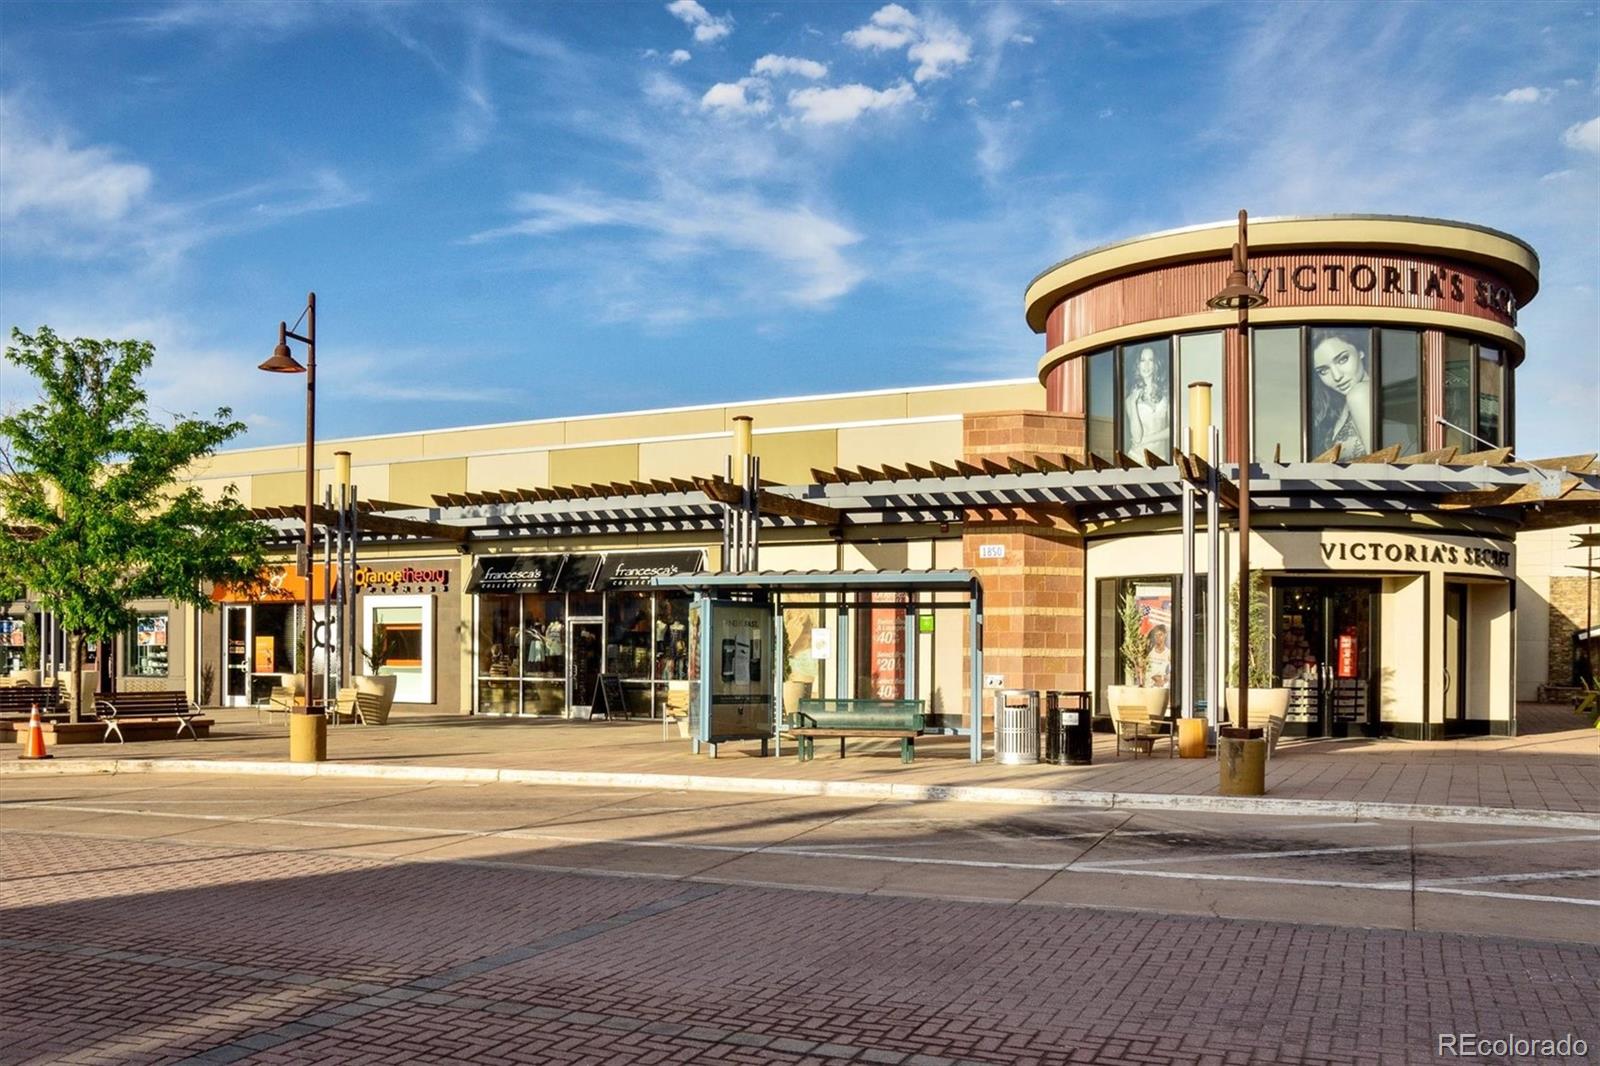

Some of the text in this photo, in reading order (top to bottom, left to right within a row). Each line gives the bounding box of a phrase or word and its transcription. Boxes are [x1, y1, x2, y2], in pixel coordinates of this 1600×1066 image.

[1250, 264, 1464, 302] VICTORIA'S
[983, 547, 1003, 557] 1850
[1320, 543, 1510, 567] VICTORIA'S SECRET
[355, 566, 446, 588] Orangetheory
[485, 566, 542, 580] francesca's
[615, 562, 679, 577] francesca's
